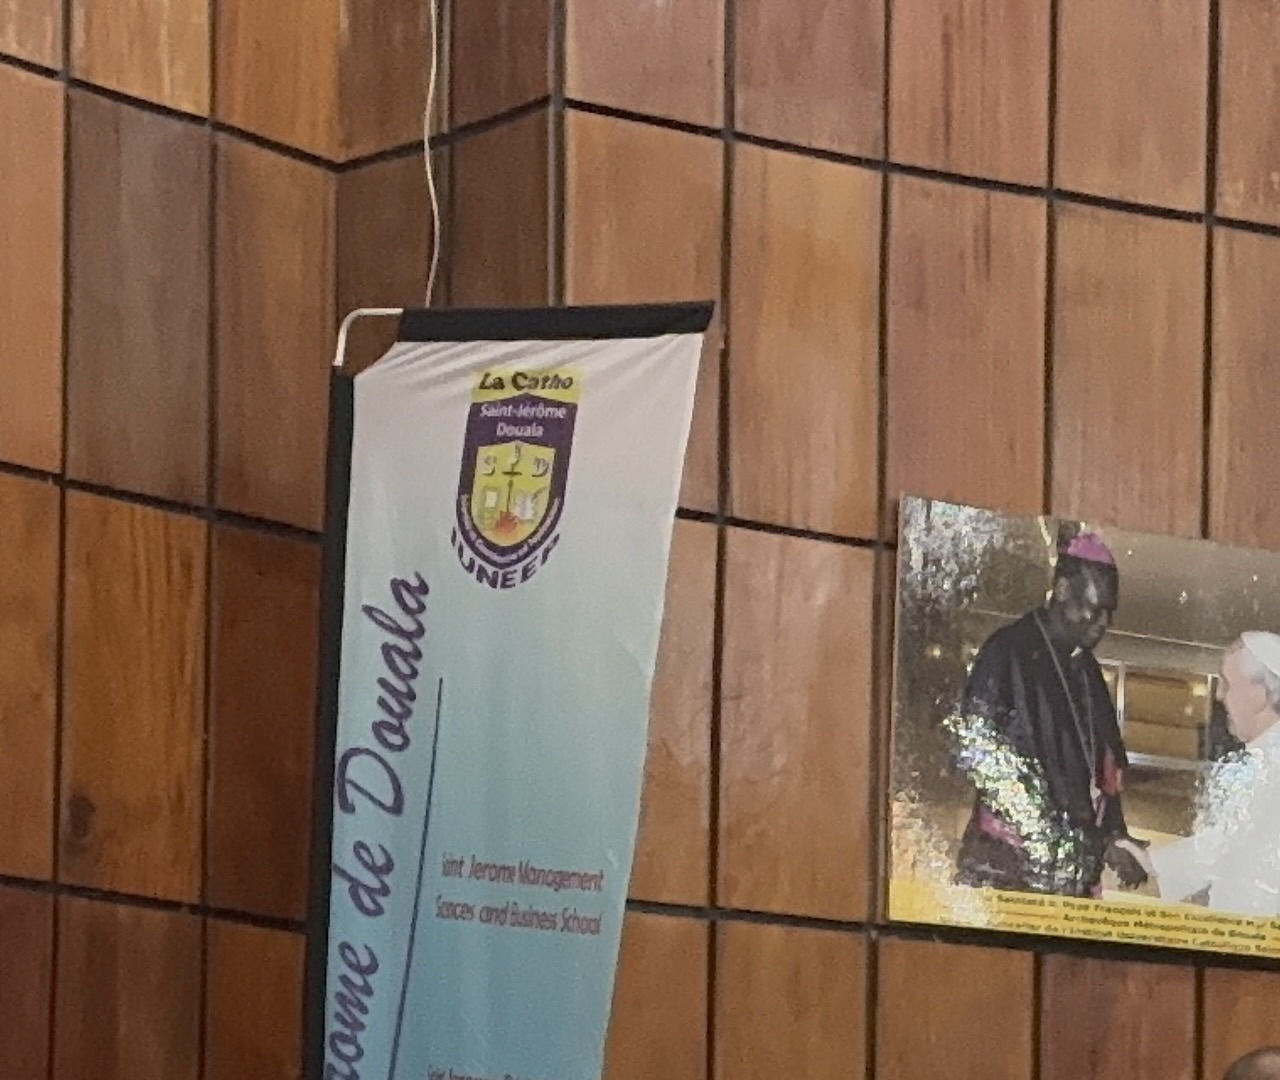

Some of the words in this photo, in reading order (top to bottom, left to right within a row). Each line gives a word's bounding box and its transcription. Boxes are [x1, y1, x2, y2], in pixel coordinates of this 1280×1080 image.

[478, 372, 505, 390] La
[511, 371, 573, 391] Catho
[496, 422, 544, 437] Douala
[336, 571, 430, 818] Douala
[332, 840, 395, 918] de
